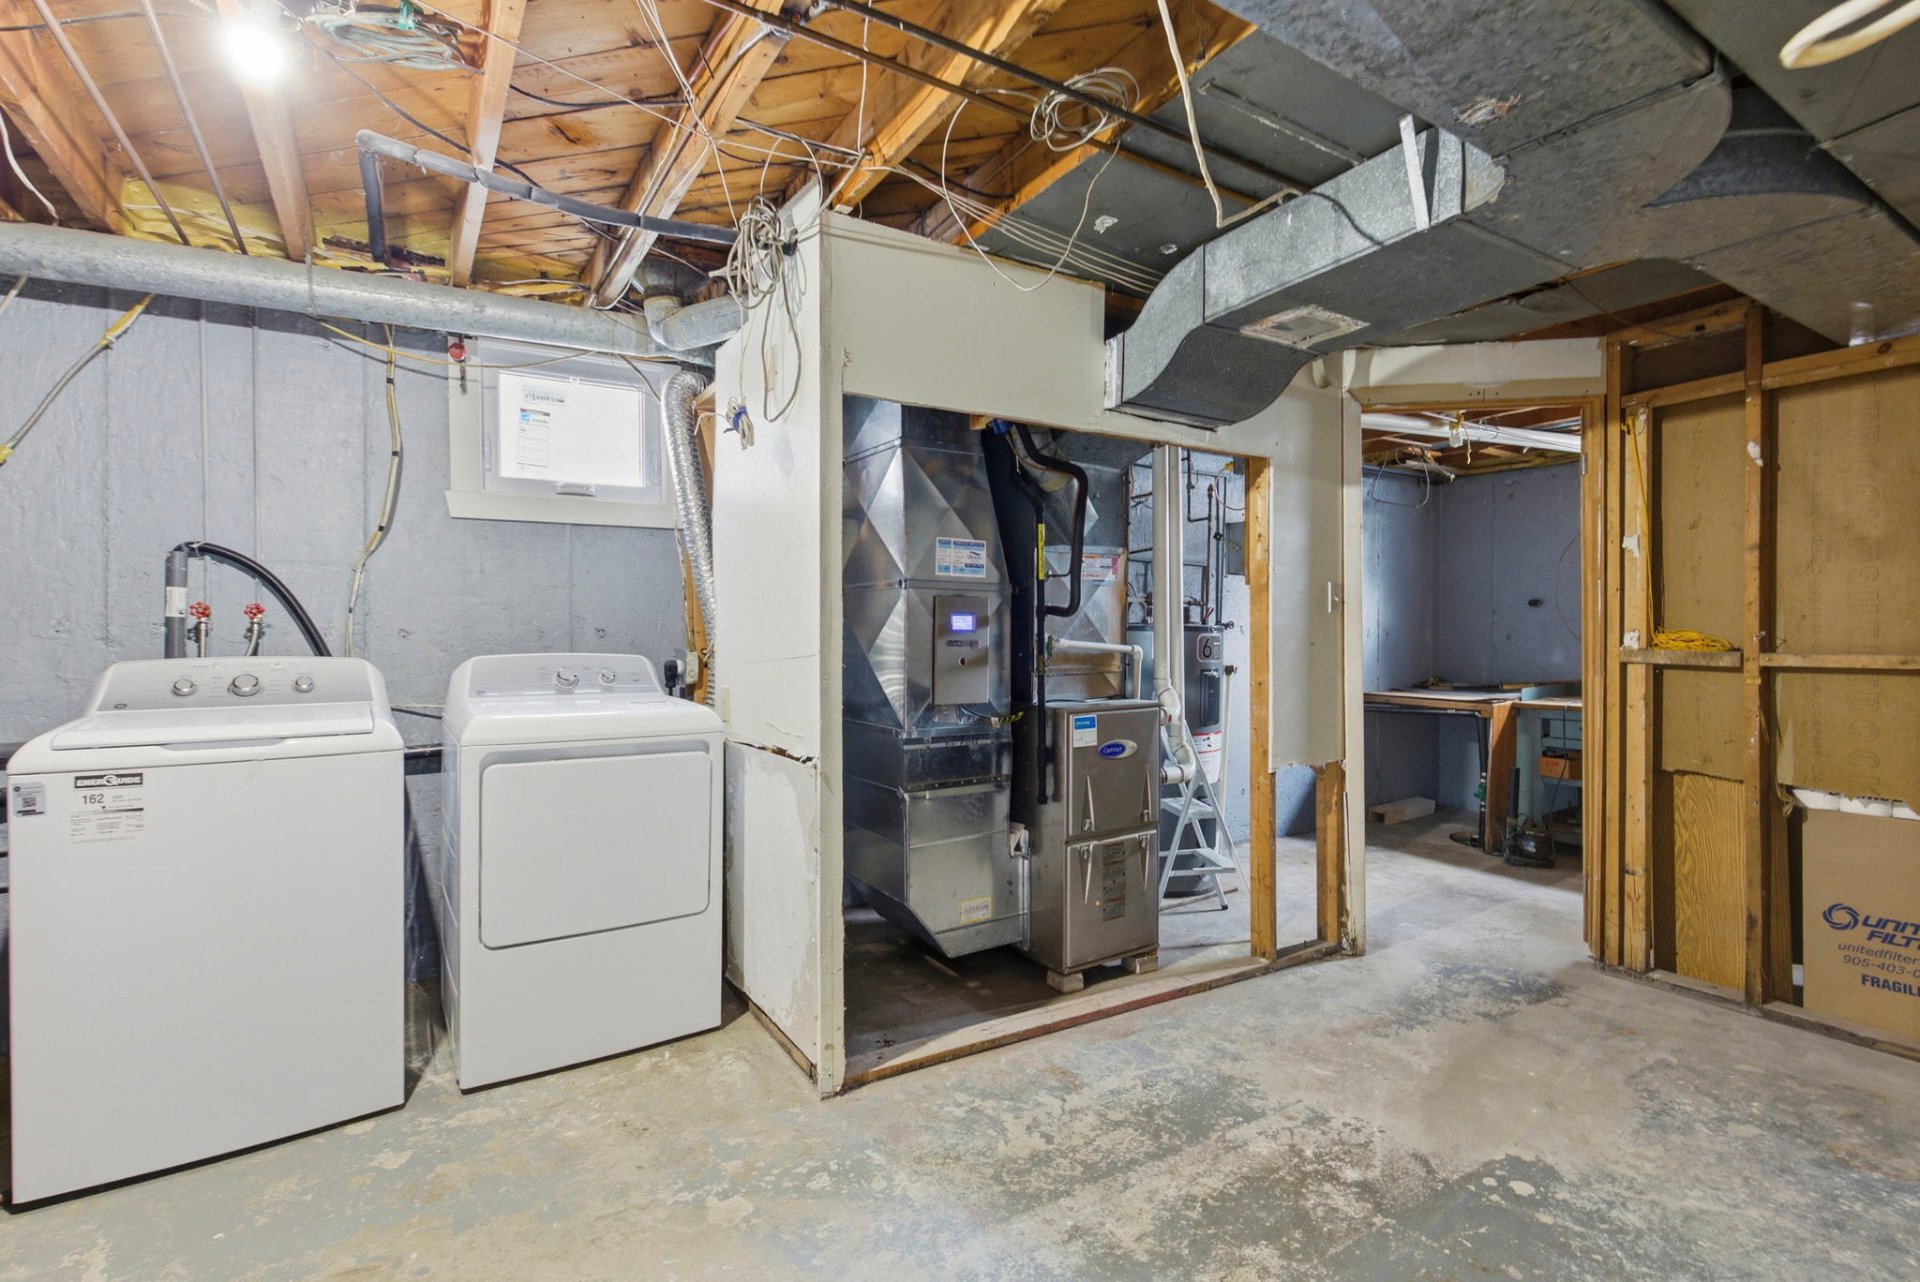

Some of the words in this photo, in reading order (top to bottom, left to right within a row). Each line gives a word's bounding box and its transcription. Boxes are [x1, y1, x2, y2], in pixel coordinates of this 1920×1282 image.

[1202, 637, 1213, 658] 6
[82, 793, 104, 805] 162
[1867, 930, 1920, 950] FILT
